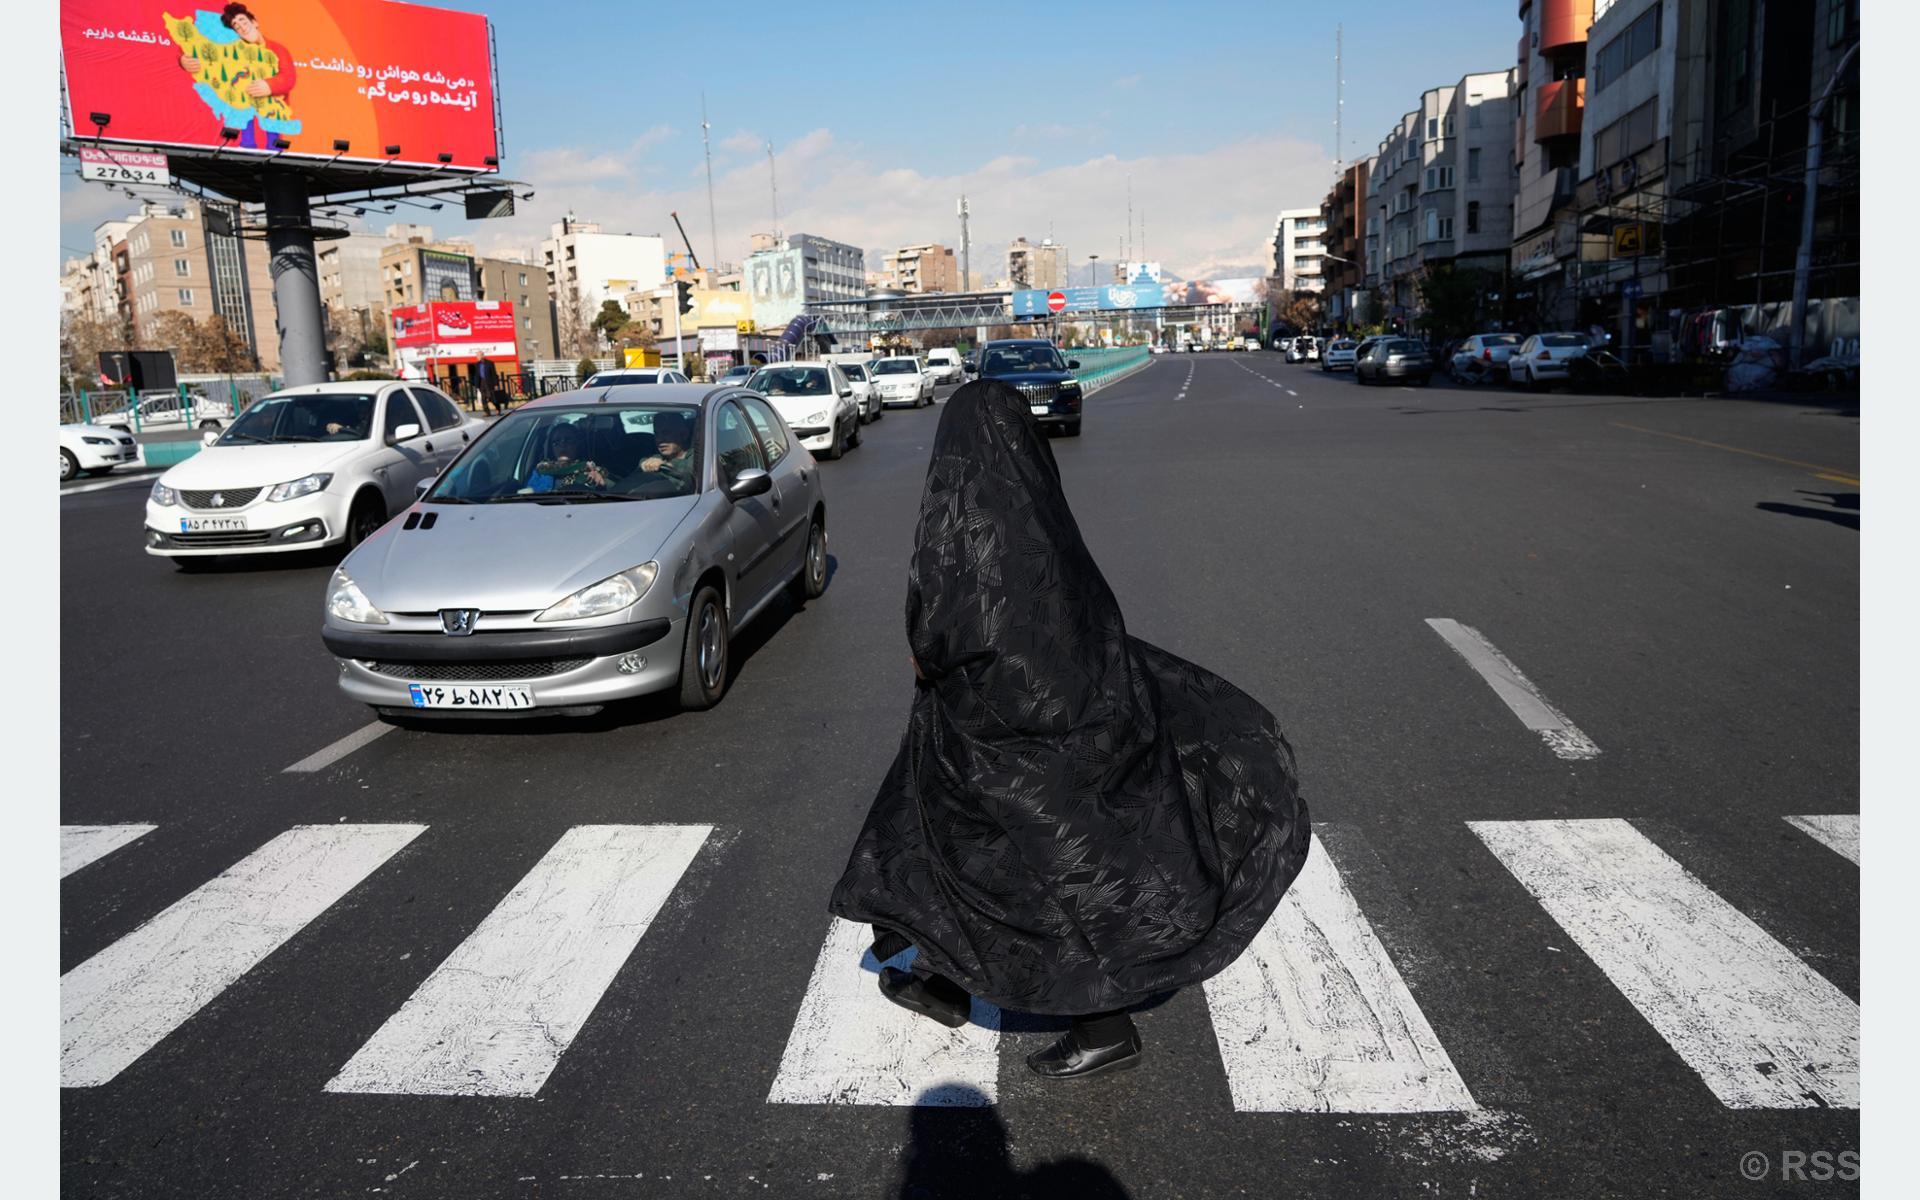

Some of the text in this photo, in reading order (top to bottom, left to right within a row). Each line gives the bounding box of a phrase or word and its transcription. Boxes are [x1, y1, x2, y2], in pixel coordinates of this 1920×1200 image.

[117, 29, 156, 43] نقشه
[158, 34, 171, 46] ما
[357, 65, 373, 79] رو
[376, 65, 420, 83] هواش
[411, 91, 428, 105] رو
[430, 90, 477, 111] آینده
[422, 687, 530, 706] ۲۶ ط ۵۸۲ ۱۱
